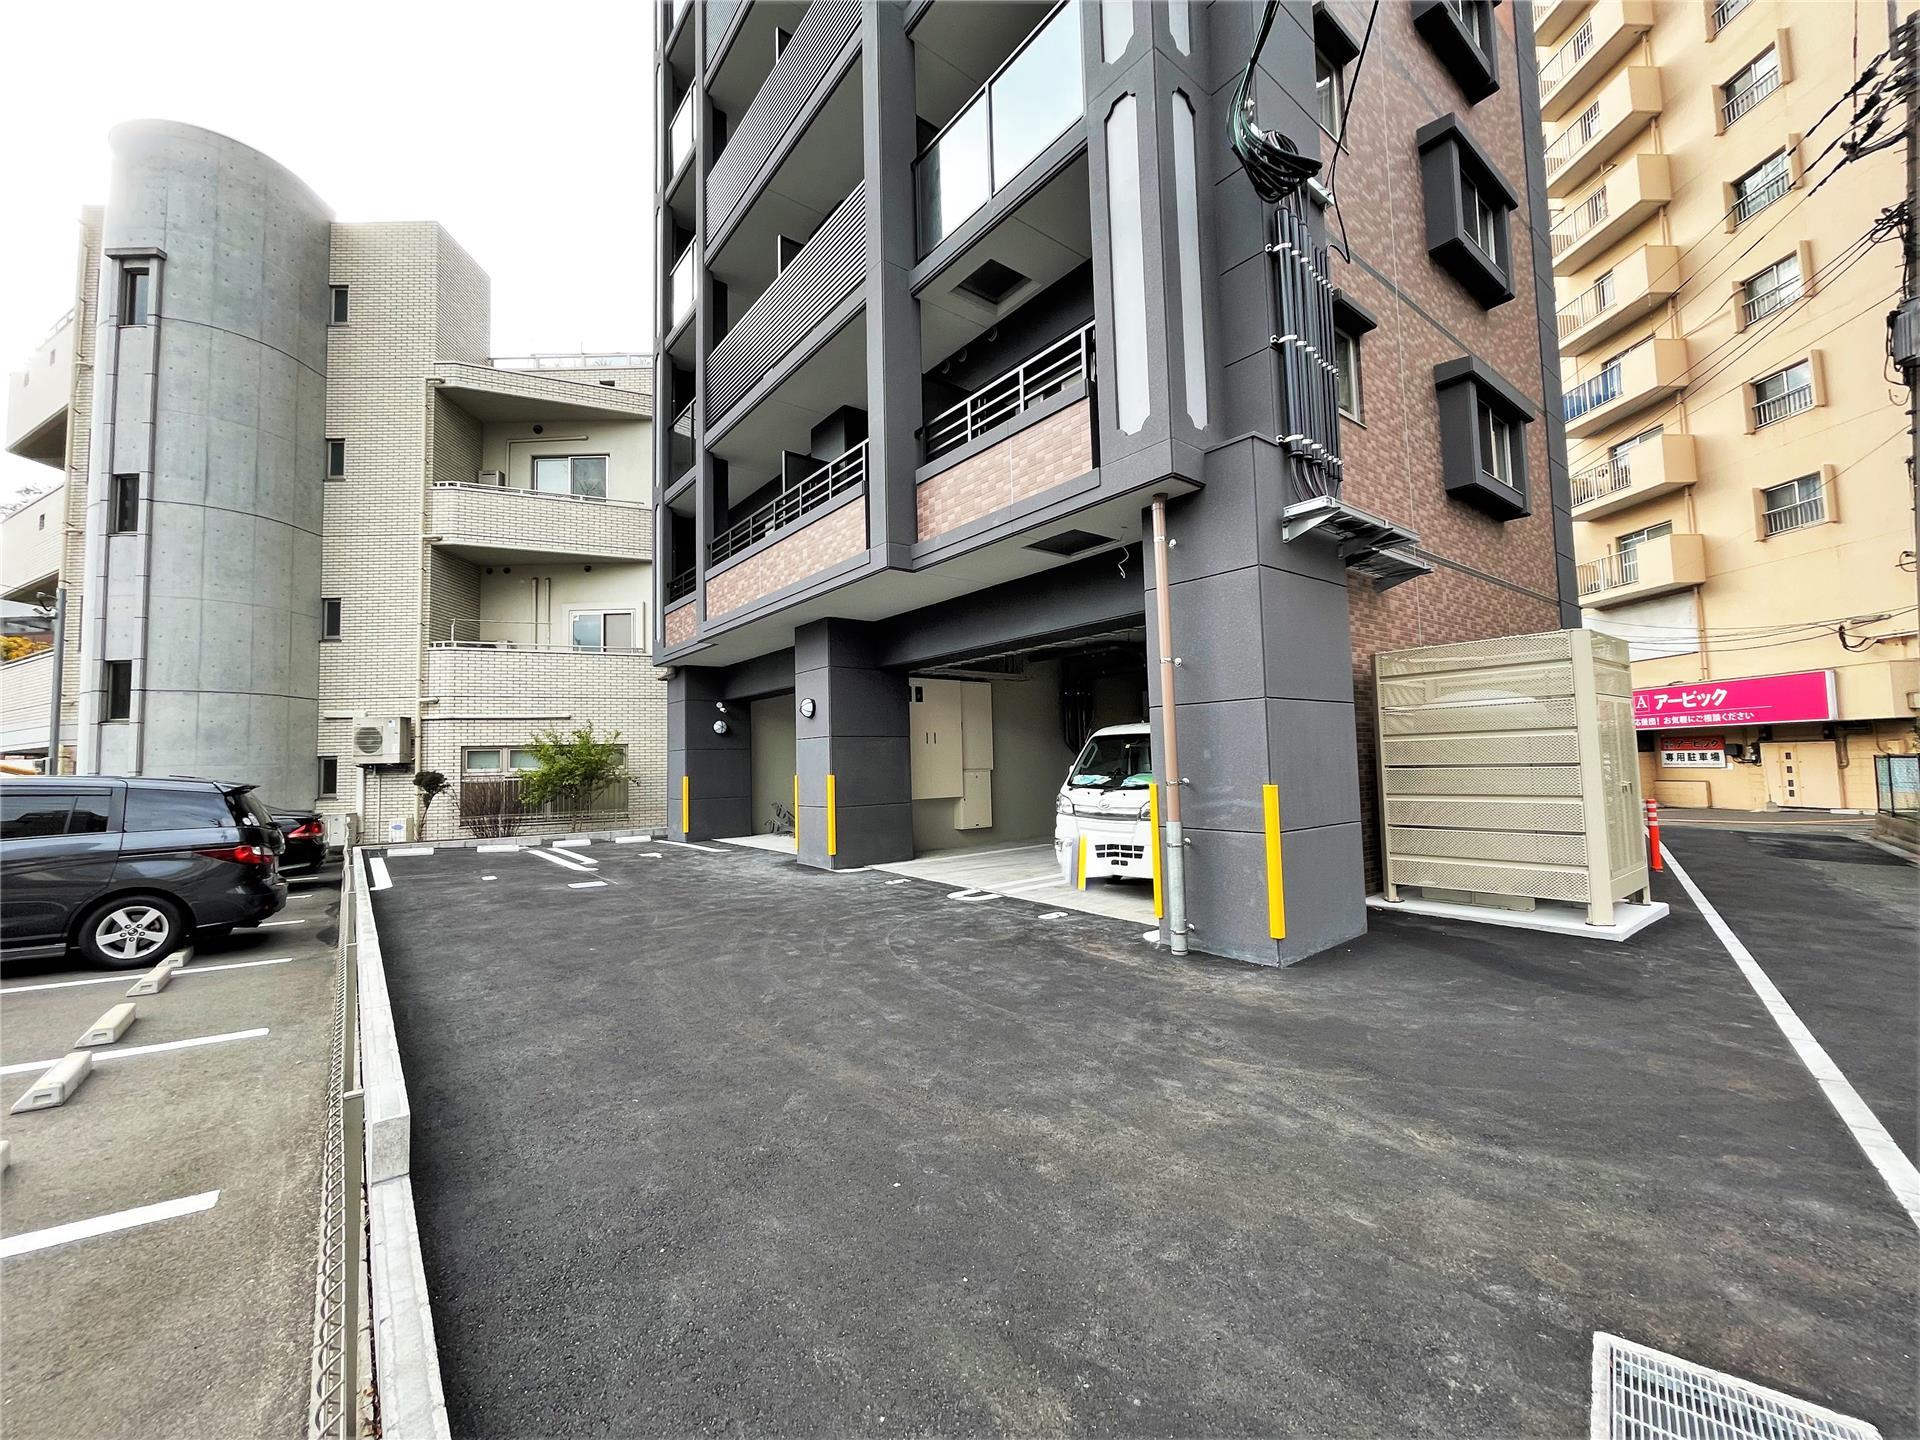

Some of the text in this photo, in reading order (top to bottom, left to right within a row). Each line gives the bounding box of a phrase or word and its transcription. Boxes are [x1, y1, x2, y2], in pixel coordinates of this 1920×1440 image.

[1636, 696, 1648, 708] A
[1654, 688, 1728, 710] アービック
[1664, 712, 1755, 725] お気軽にご相談ください
[1665, 752, 1720, 762] 専用駐車場
